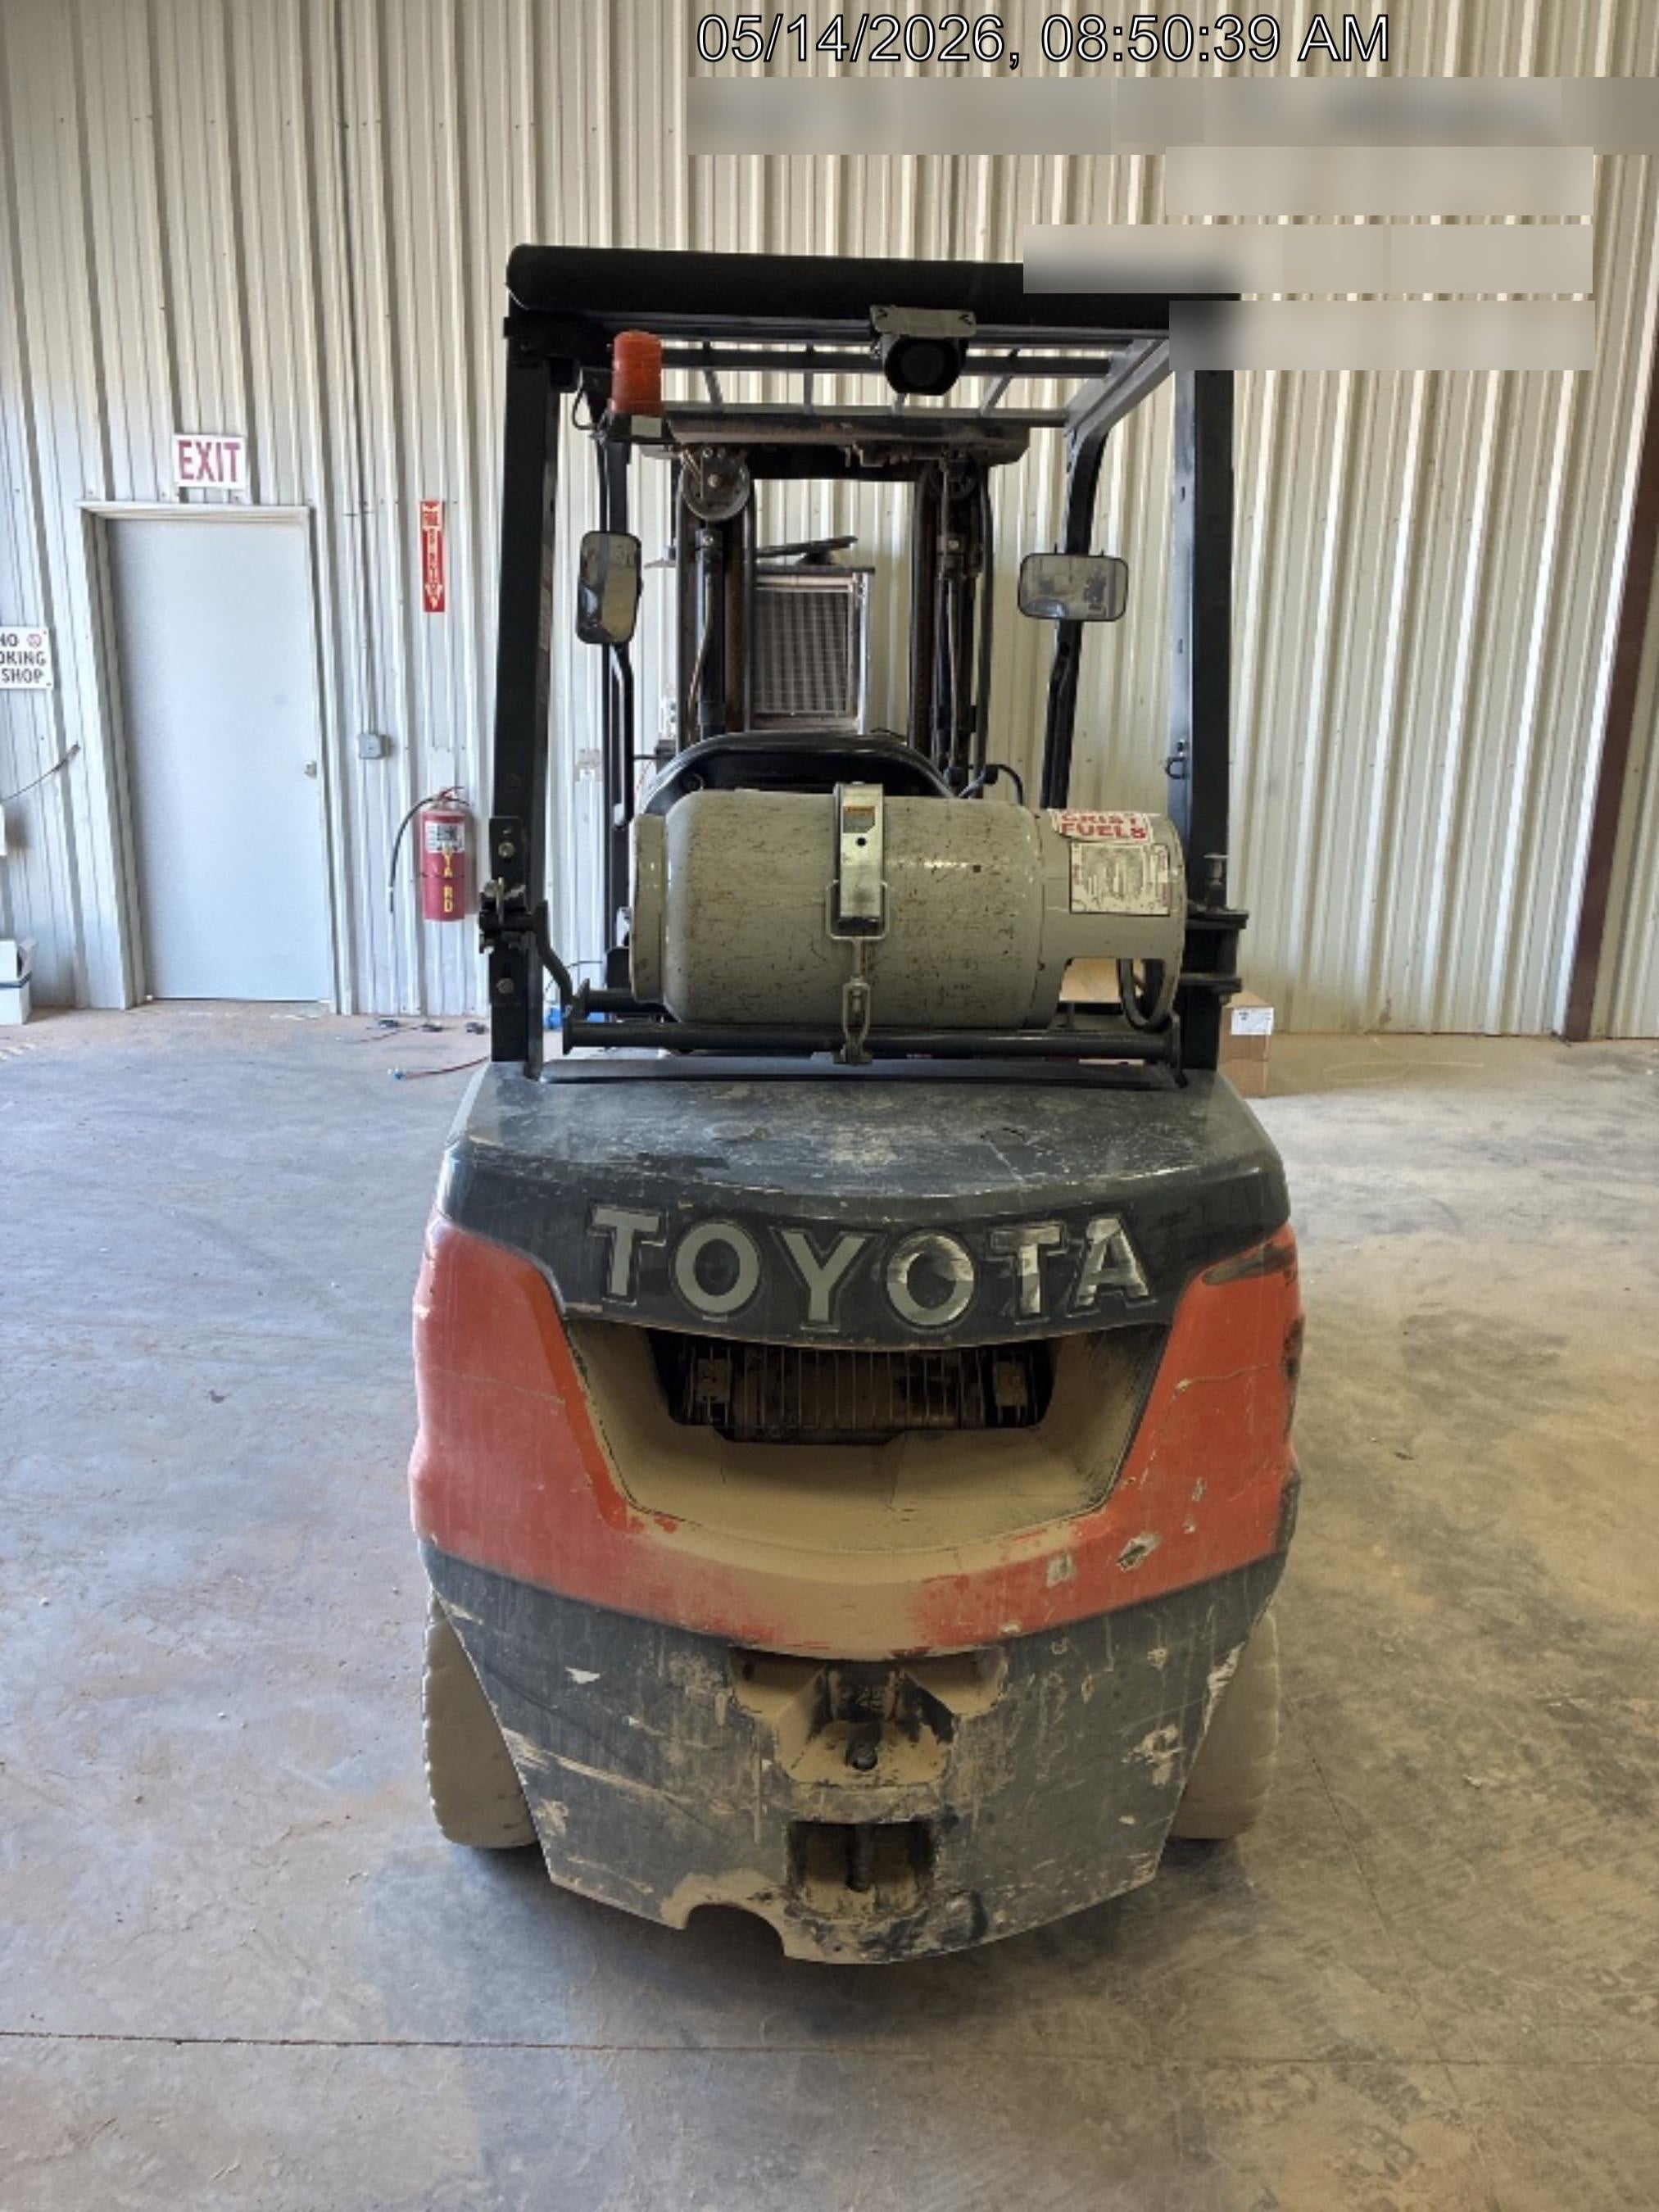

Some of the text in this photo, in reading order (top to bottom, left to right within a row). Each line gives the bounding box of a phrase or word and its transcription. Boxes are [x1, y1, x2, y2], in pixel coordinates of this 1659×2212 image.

[178, 440, 241, 483] EXIT
[2, 668, 44, 684] SHOP
[442, 846, 454, 913] YARD
[590, 1206, 1151, 1329] TOYOTA
